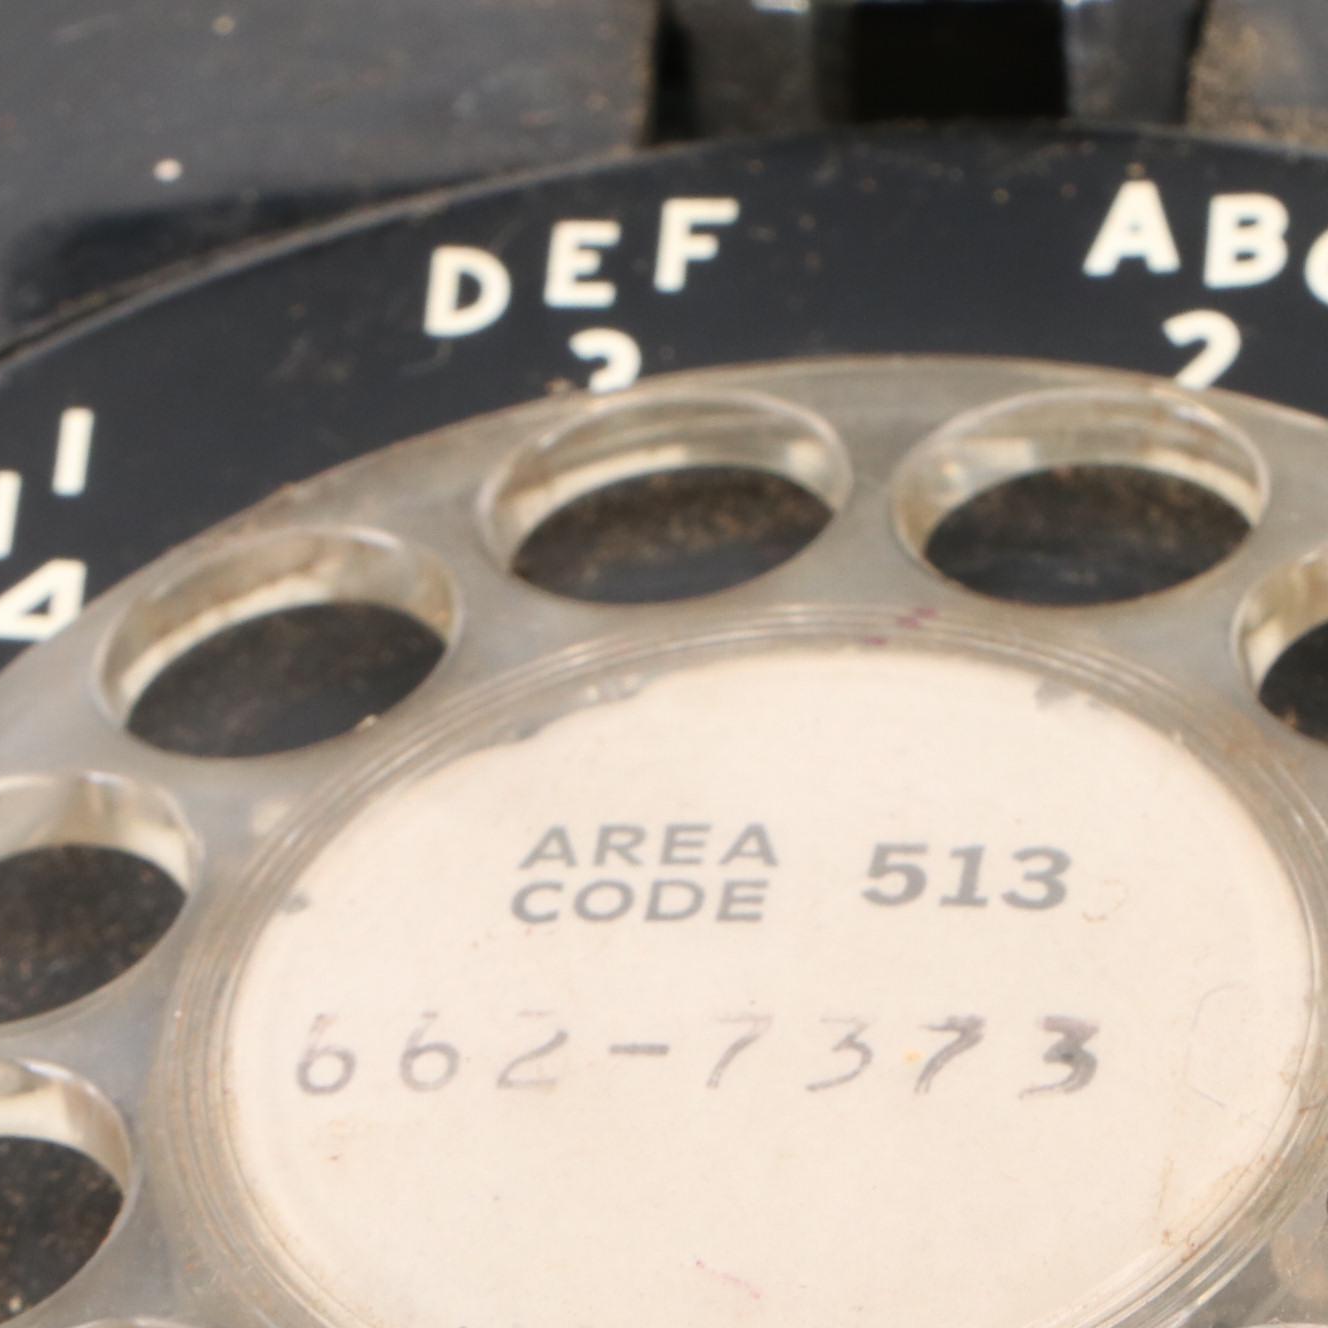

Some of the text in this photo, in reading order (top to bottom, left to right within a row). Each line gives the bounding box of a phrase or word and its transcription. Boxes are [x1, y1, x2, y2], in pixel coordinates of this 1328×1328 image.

[423, 197, 740, 338] DEF
[1161, 308, 1242, 391] 2
[517, 821, 780, 870] AREA
[860, 841, 1073, 912] 513
[509, 878, 770, 925] CODE
[295, 1008, 1102, 1101] 662-7373
